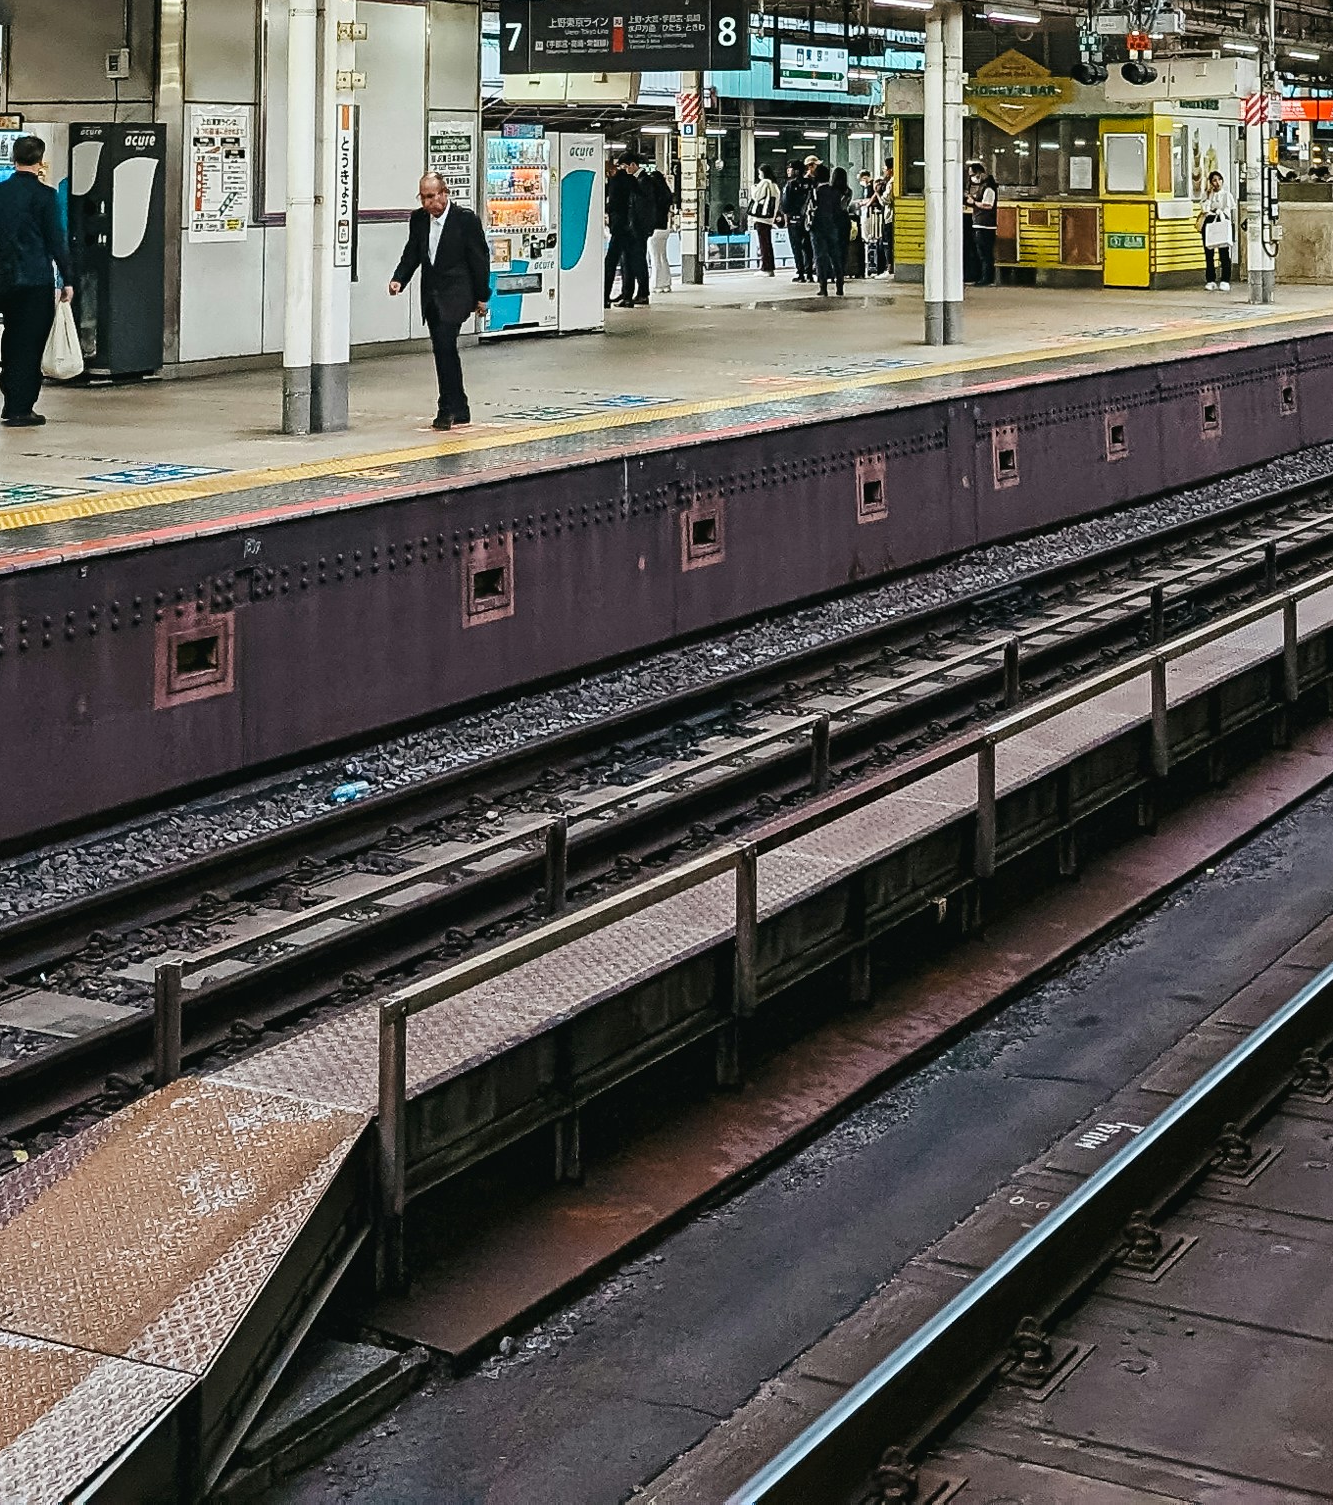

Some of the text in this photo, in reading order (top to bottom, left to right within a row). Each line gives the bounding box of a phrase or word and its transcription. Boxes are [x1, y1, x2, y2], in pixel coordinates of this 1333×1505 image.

[548, 17, 609, 28] 上野東京ライン
[505, 23, 522, 51] 7
[718, 17, 737, 47] 8
[80, 128, 103, 136] acure
[125, 134, 156, 147] acure
[569, 145, 595, 158] acure
[340, 136, 349, 215] とうきょう
[534, 258, 555, 270] acure
